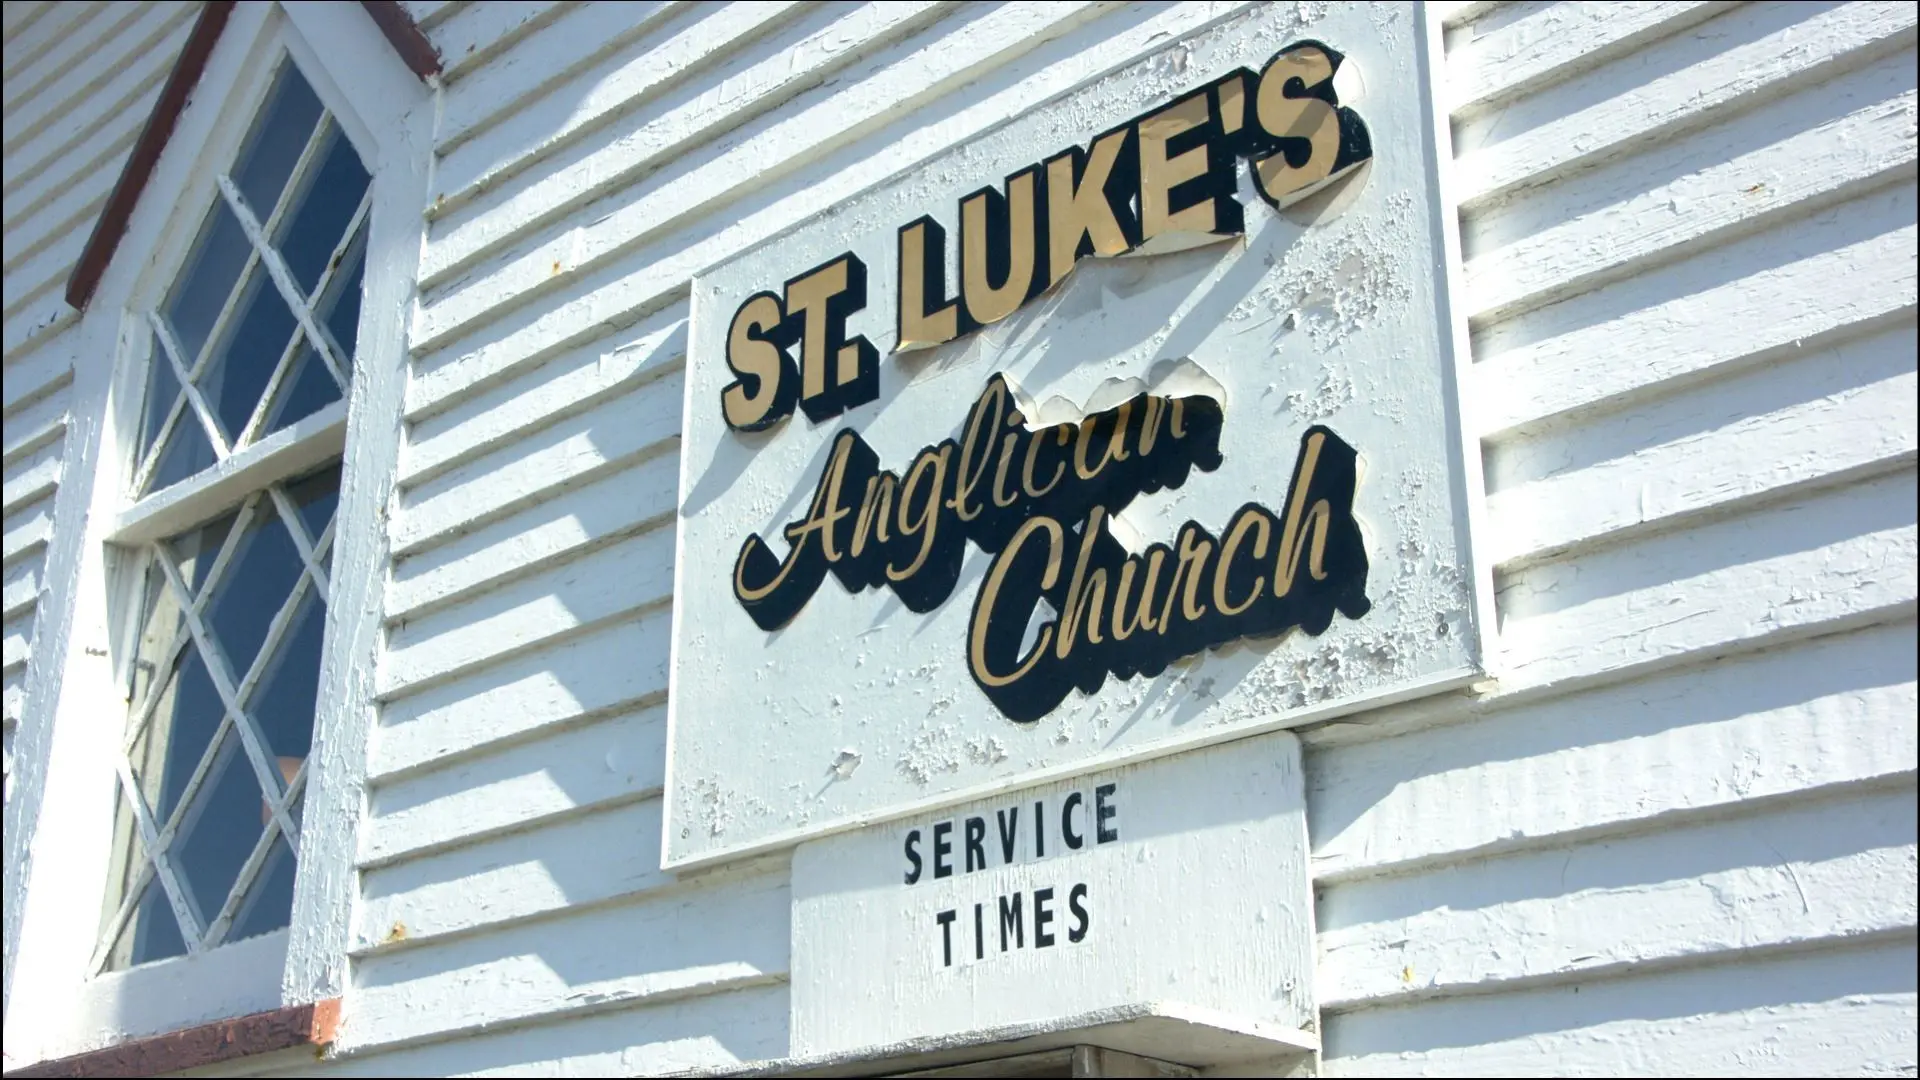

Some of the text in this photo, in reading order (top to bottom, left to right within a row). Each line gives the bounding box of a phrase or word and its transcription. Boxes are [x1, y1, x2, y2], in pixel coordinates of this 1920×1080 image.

[722, 40, 1358, 430] ST. LUKE'S
[735, 376, 1200, 604] Anglican
[969, 430, 1332, 688] Church
[904, 783, 1119, 886] SERVICE
[936, 882, 1090, 967] TIMES
